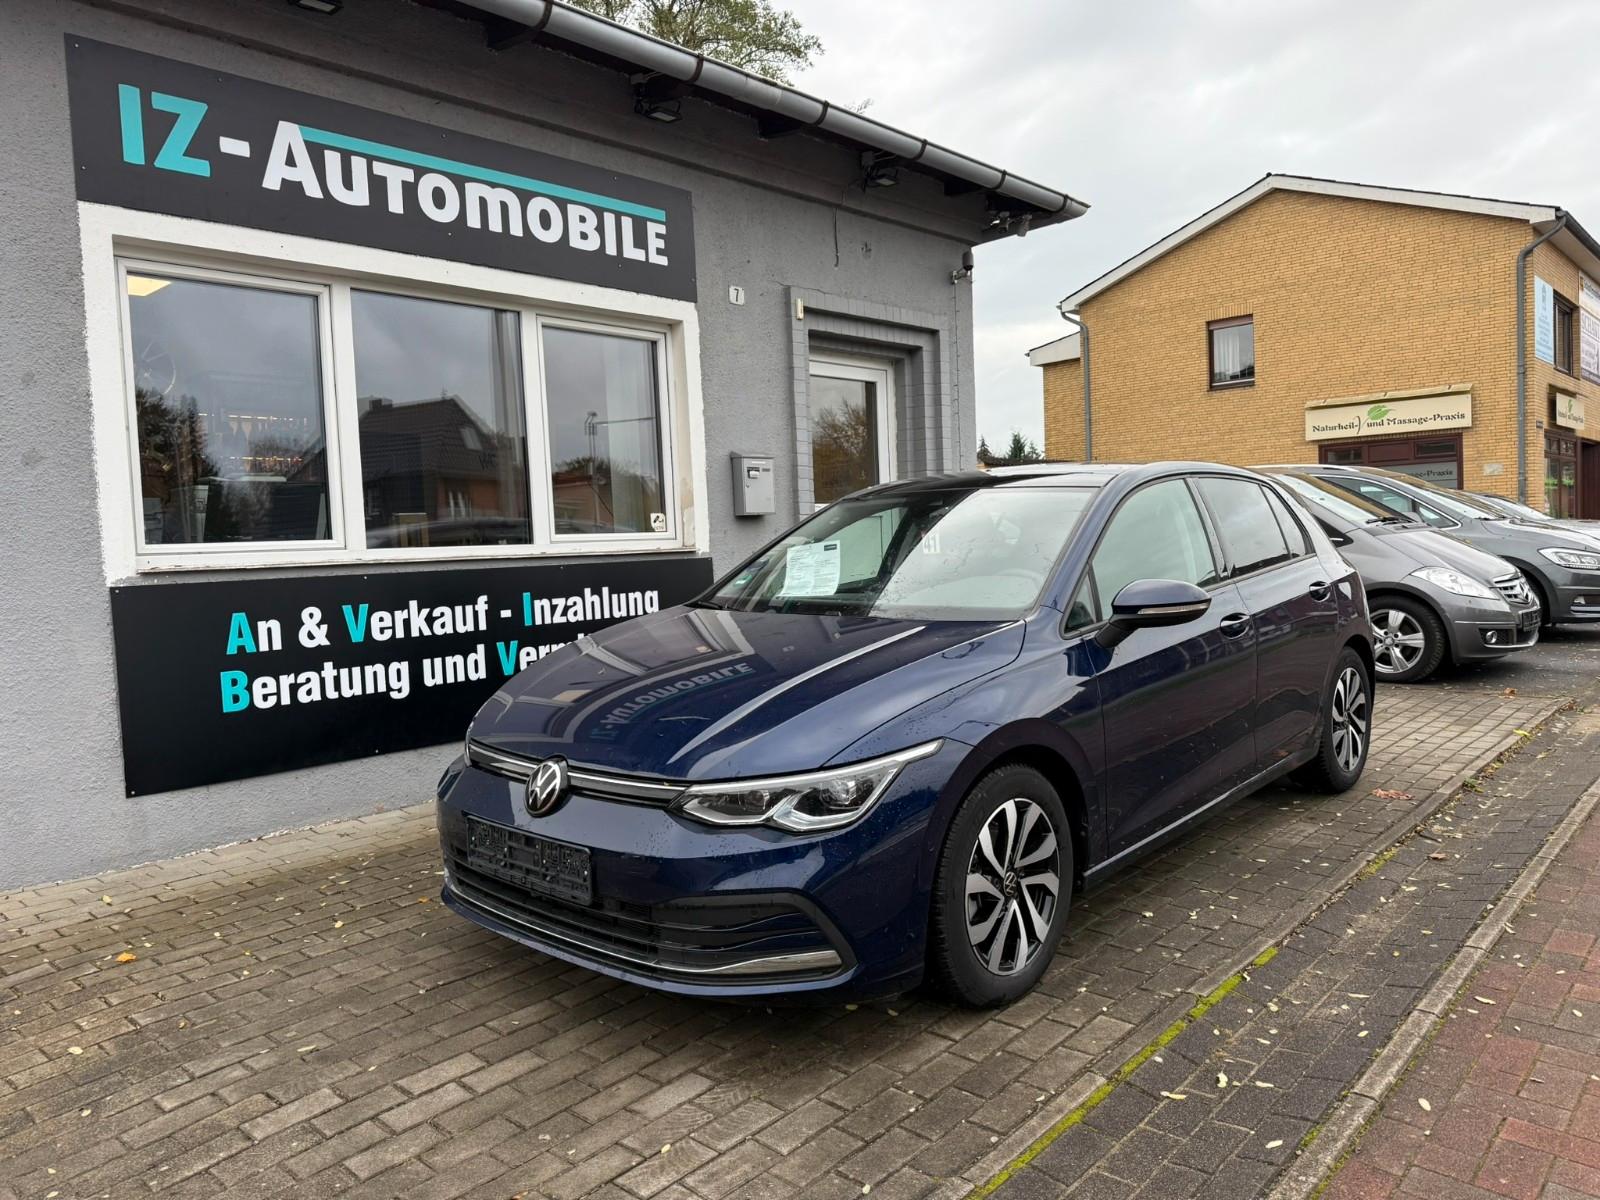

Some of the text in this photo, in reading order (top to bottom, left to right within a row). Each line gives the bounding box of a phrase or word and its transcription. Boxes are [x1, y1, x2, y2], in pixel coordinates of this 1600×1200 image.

[733, 287, 740, 303] 7
[1312, 412, 1465, 432] Naturheil- und Massage-Praxis
[226, 586, 659, 655] An & Verkauf - Inzahlung
[220, 661, 410, 713] Beratung
[422, 644, 487, 687] und
